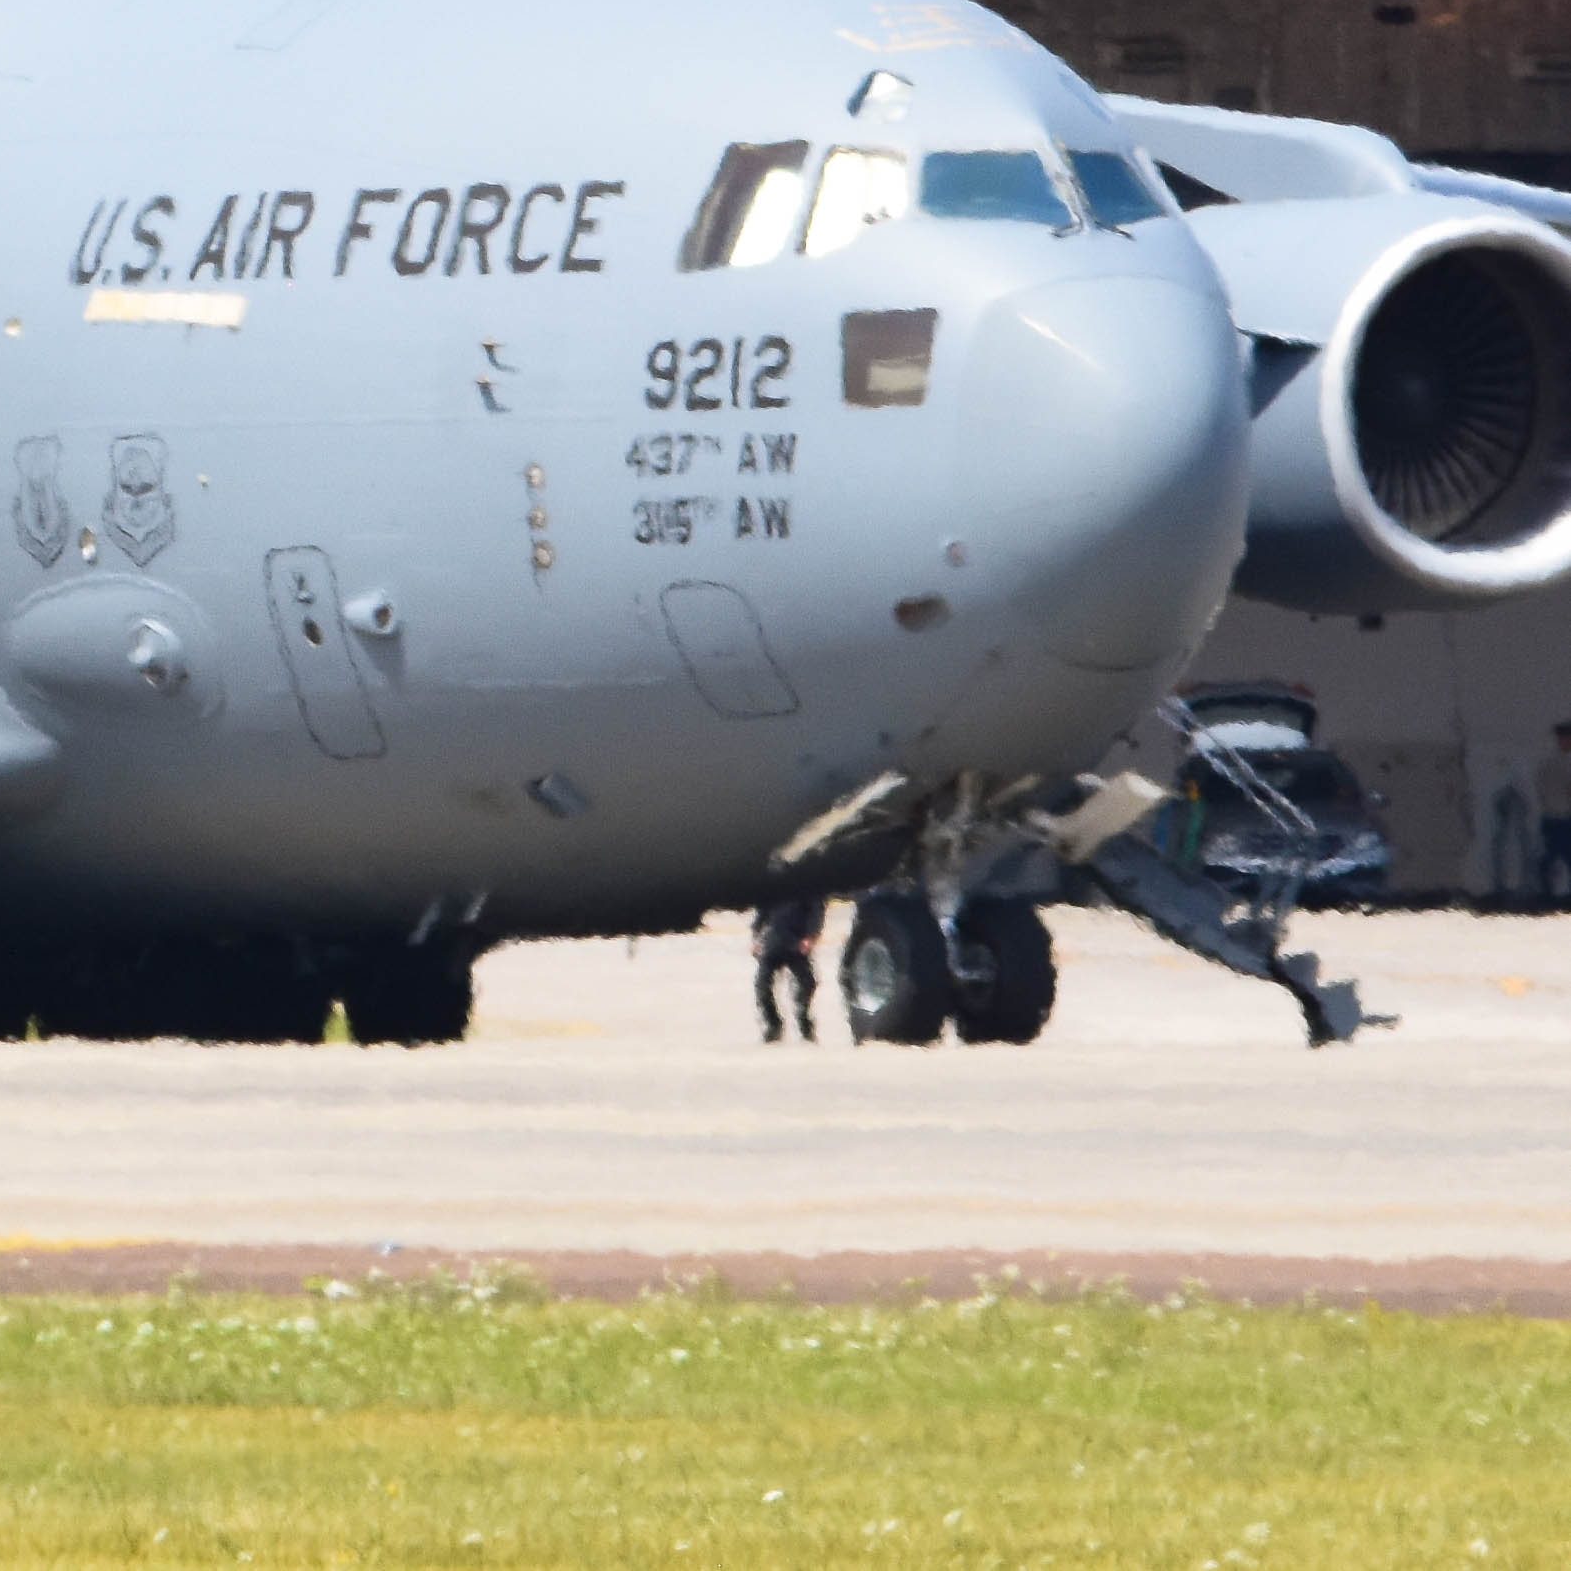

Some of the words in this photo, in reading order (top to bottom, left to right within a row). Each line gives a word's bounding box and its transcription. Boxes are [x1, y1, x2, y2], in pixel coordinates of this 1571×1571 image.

[69, 195, 176, 286] U.S.
[189, 190, 314, 281] AIR
[333, 180, 625, 278] FORCE
[645, 334, 791, 411] 9212
[738, 432, 798, 475] AW
[735, 495, 791, 540] AW
